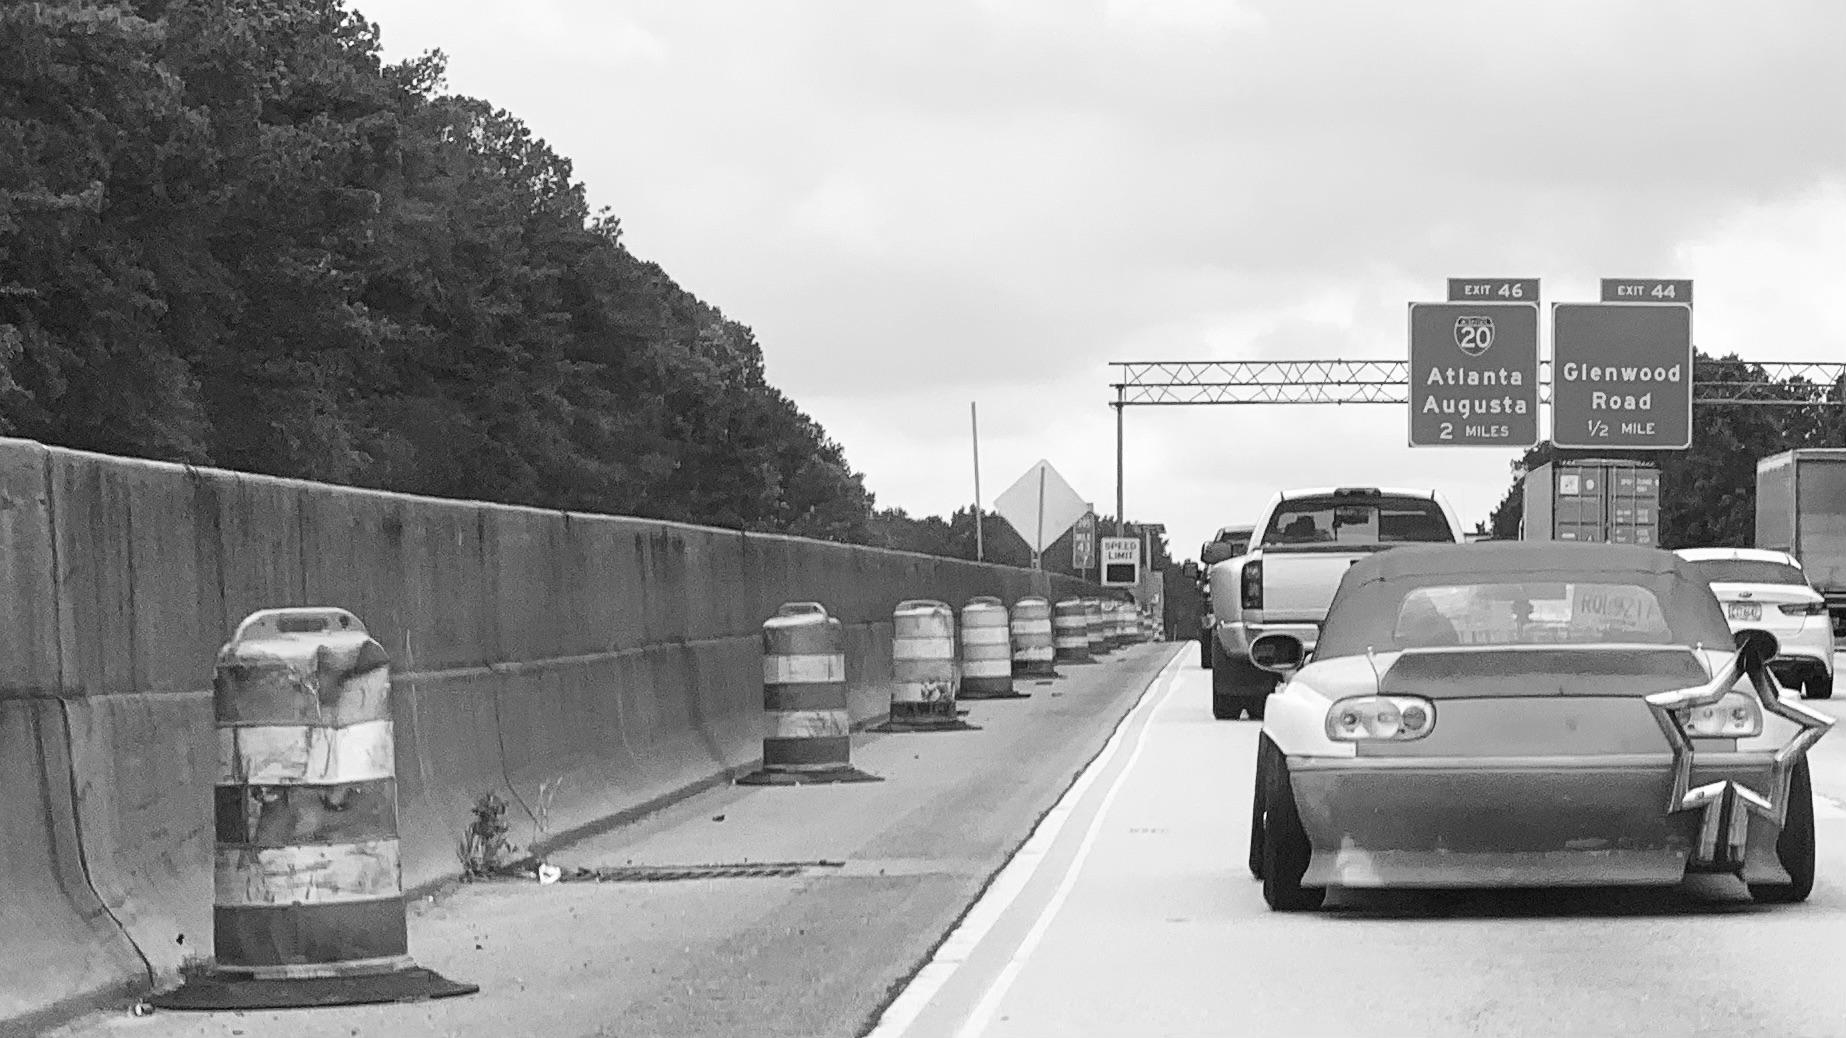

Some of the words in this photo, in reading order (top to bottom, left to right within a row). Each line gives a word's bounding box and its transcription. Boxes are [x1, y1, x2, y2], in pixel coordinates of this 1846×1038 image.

[1464, 285, 1491, 295] EXIT
[1498, 283, 1523, 298] 46
[1617, 285, 1645, 296] EXIT
[1651, 283, 1676, 298] 44
[1460, 325, 1491, 348] 20
[1426, 367, 1523, 385] Atlanta
[1563, 362, 1681, 382] Glenwood
[1422, 395, 1527, 419] Augusta
[1592, 391, 1651, 410] Road
[1439, 422, 1453, 440] 2
[1465, 425, 1509, 438] MILES
[1621, 422, 1656, 435] MILE
[1104, 541, 1137, 550] SPEED
[1108, 551, 1133, 560] LIMIT
